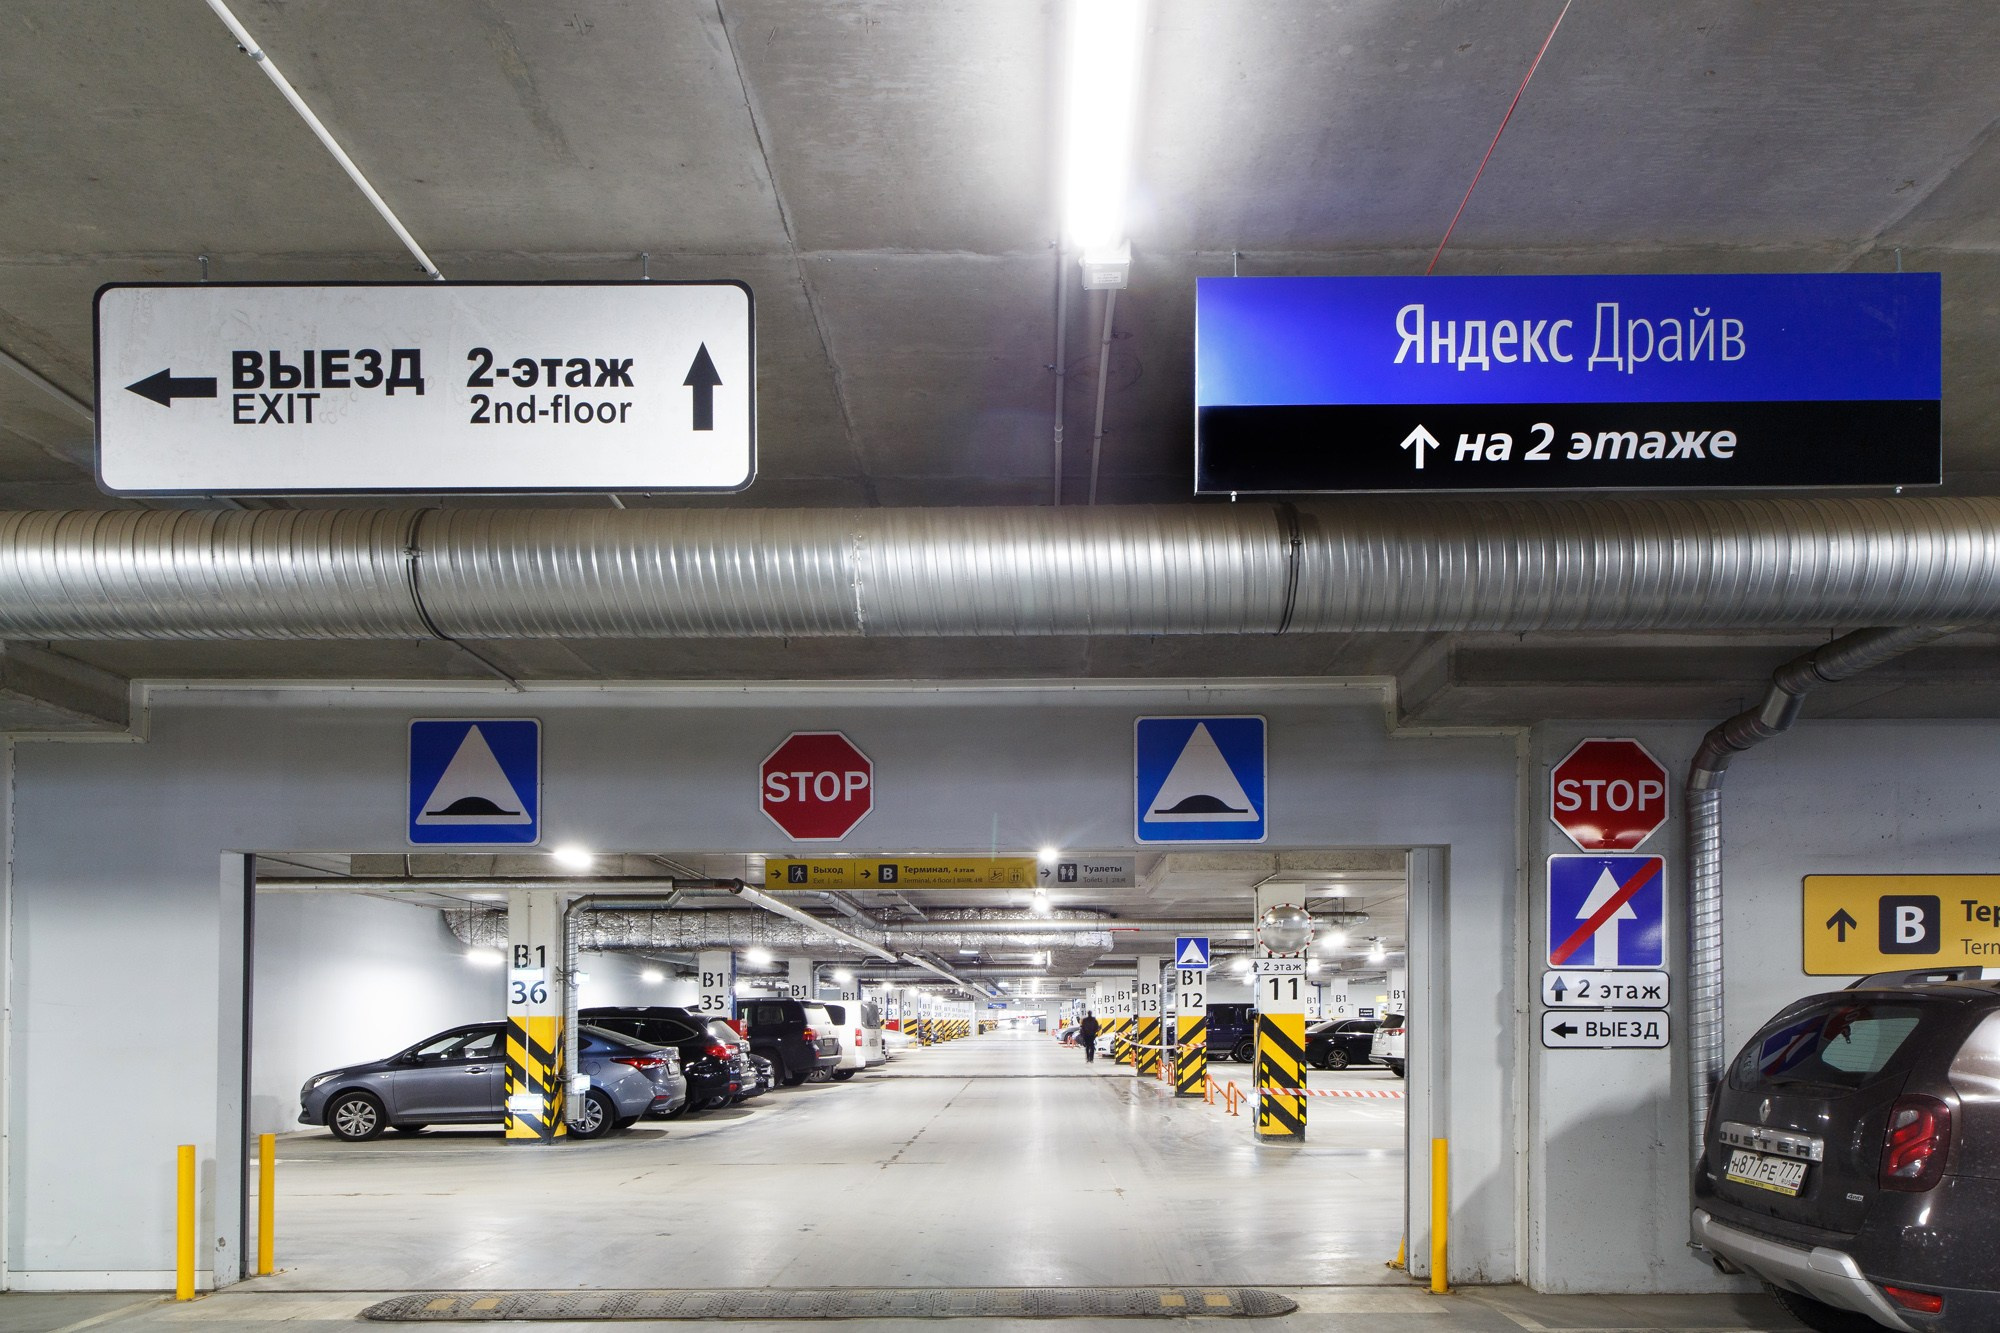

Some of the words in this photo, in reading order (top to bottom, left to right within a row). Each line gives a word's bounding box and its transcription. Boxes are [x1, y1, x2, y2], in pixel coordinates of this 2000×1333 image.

[1393, 304, 1573, 372] Яндекс
[1588, 302, 1746, 374] Драйв
[231, 349, 425, 396] ВЫЕЗД
[466, 347, 635, 390] 2-этаж
[232, 394, 321, 424] EXIT
[469, 394, 632, 425] 2nd-floor
[1454, 432, 1512, 462] на
[1523, 422, 1555, 461] 2
[1567, 427, 1738, 461] этаже
[765, 771, 869, 803] STOP
[1555, 778, 1664, 812] STOP
[813, 866, 844, 875] Выход
[903, 865, 951, 875] Терминал,
[1083, 865, 1122, 874] Туалеты
[1895, 906, 1926, 944] B
[514, 944, 546, 968] B1
[1263, 962, 1270, 971] 2
[1274, 963, 1302, 971] этаж
[702, 972, 724, 987] B1
[1182, 970, 1203, 985] B1
[511, 980, 548, 1004] 36
[791, 985, 807, 997] B1
[842, 991, 855, 1000] B1
[1117, 991, 1131, 1000] B1
[1141, 983, 1157, 995] B1
[1268, 977, 1298, 1000] 11
[1577, 980, 1591, 998] 2
[1600, 983, 1662, 1000] этаж
[701, 995, 725, 1010] 35
[1104, 995, 1115, 1003] B1
[1141, 1000, 1157, 1011] 13
[1181, 992, 1203, 1008] 12
[1335, 995, 1347, 1003] B1
[1104, 1006, 1115, 1014] 15
[1117, 1004, 1131, 1012] 14
[1585, 1021, 1660, 1040] ВЫЕЗД
[1720, 1131, 1810, 1157] DUSTER
